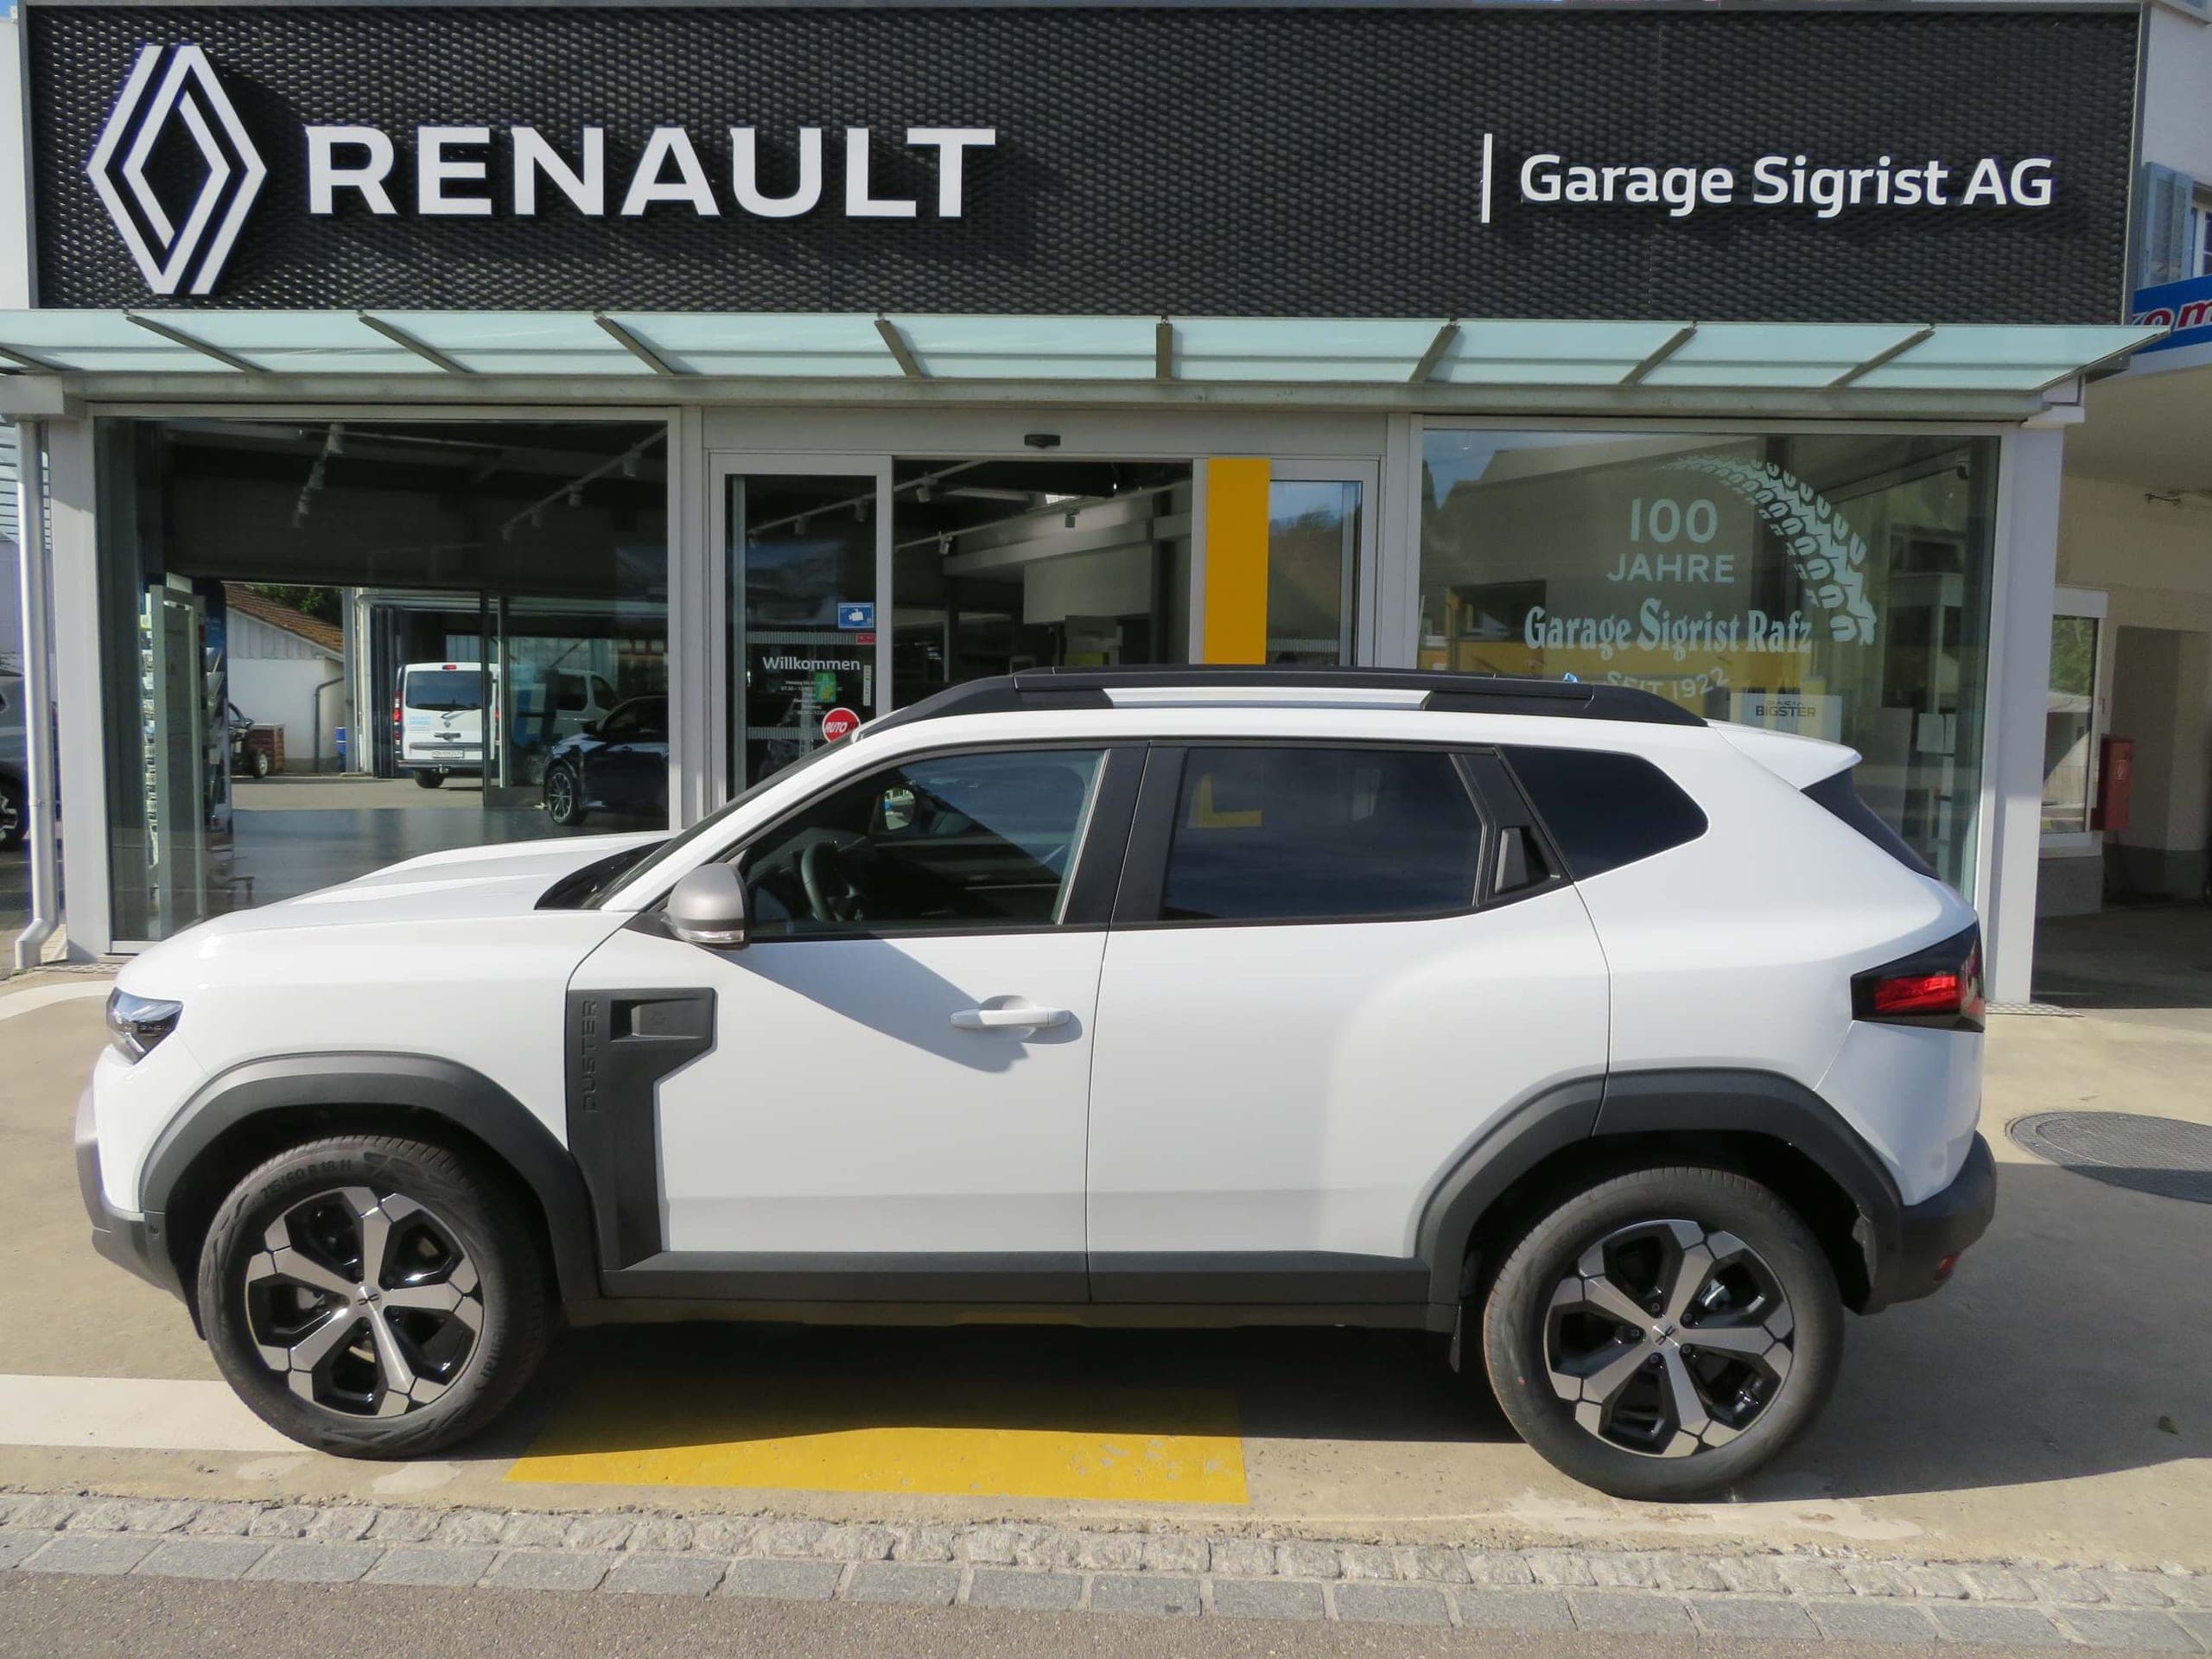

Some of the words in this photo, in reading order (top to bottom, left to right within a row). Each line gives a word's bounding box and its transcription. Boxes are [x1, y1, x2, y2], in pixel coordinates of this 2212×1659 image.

[307, 125, 996, 218] RENAULT
[1520, 154, 1733, 217] Garage
[1752, 155, 1948, 218] Sigrist
[1961, 158, 2053, 207] AG
[1630, 497, 1719, 544] 100
[1606, 553, 1735, 583] JAHRE
[1524, 606, 1632, 660] Garage
[1637, 597, 1739, 660] Sigrist
[1747, 608, 1812, 655] Rafz
[762, 657, 860, 671] Willkommen
[1672, 666, 1731, 700] 1922
[824, 721, 848, 734] AUTO
[582, 1000, 598, 1113] DUSTER
